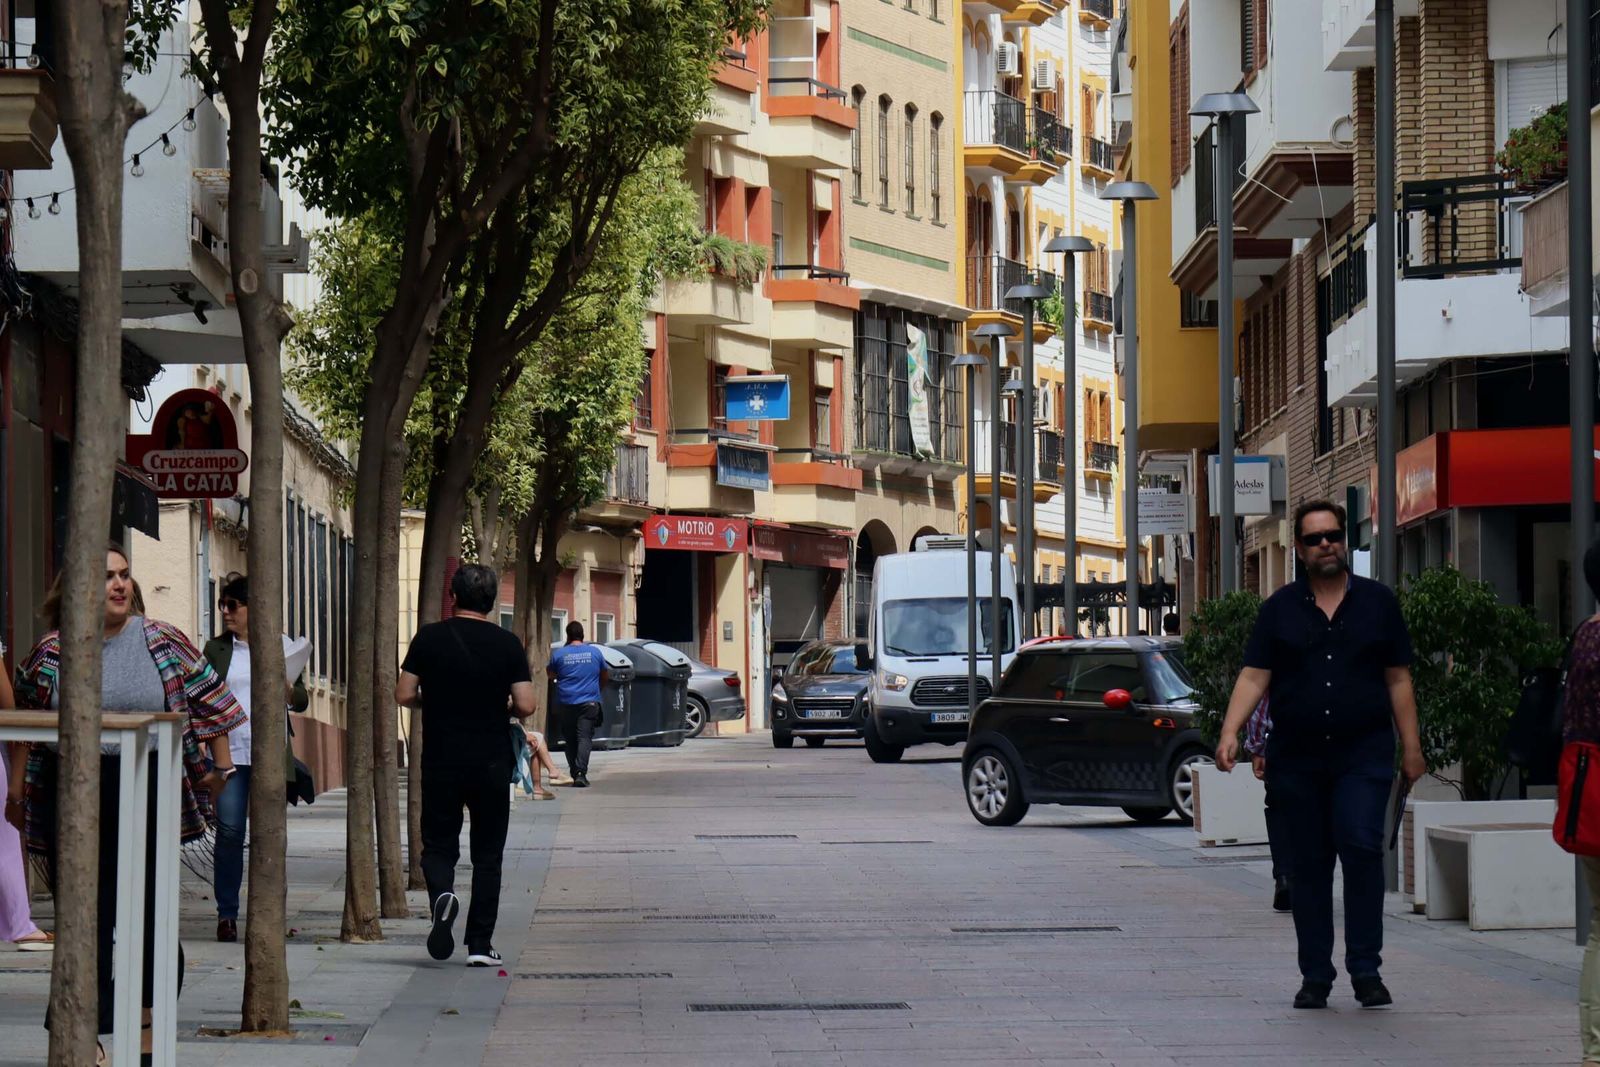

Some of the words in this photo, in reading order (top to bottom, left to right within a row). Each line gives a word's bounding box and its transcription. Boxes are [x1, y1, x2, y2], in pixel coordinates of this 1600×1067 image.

[151, 454, 239, 471] Cruzcampo
[154, 474, 178, 492] LA
[183, 474, 234, 492] CATA
[1233, 479, 1265, 489] Adeslas
[936, 713, 955, 721] 3809
